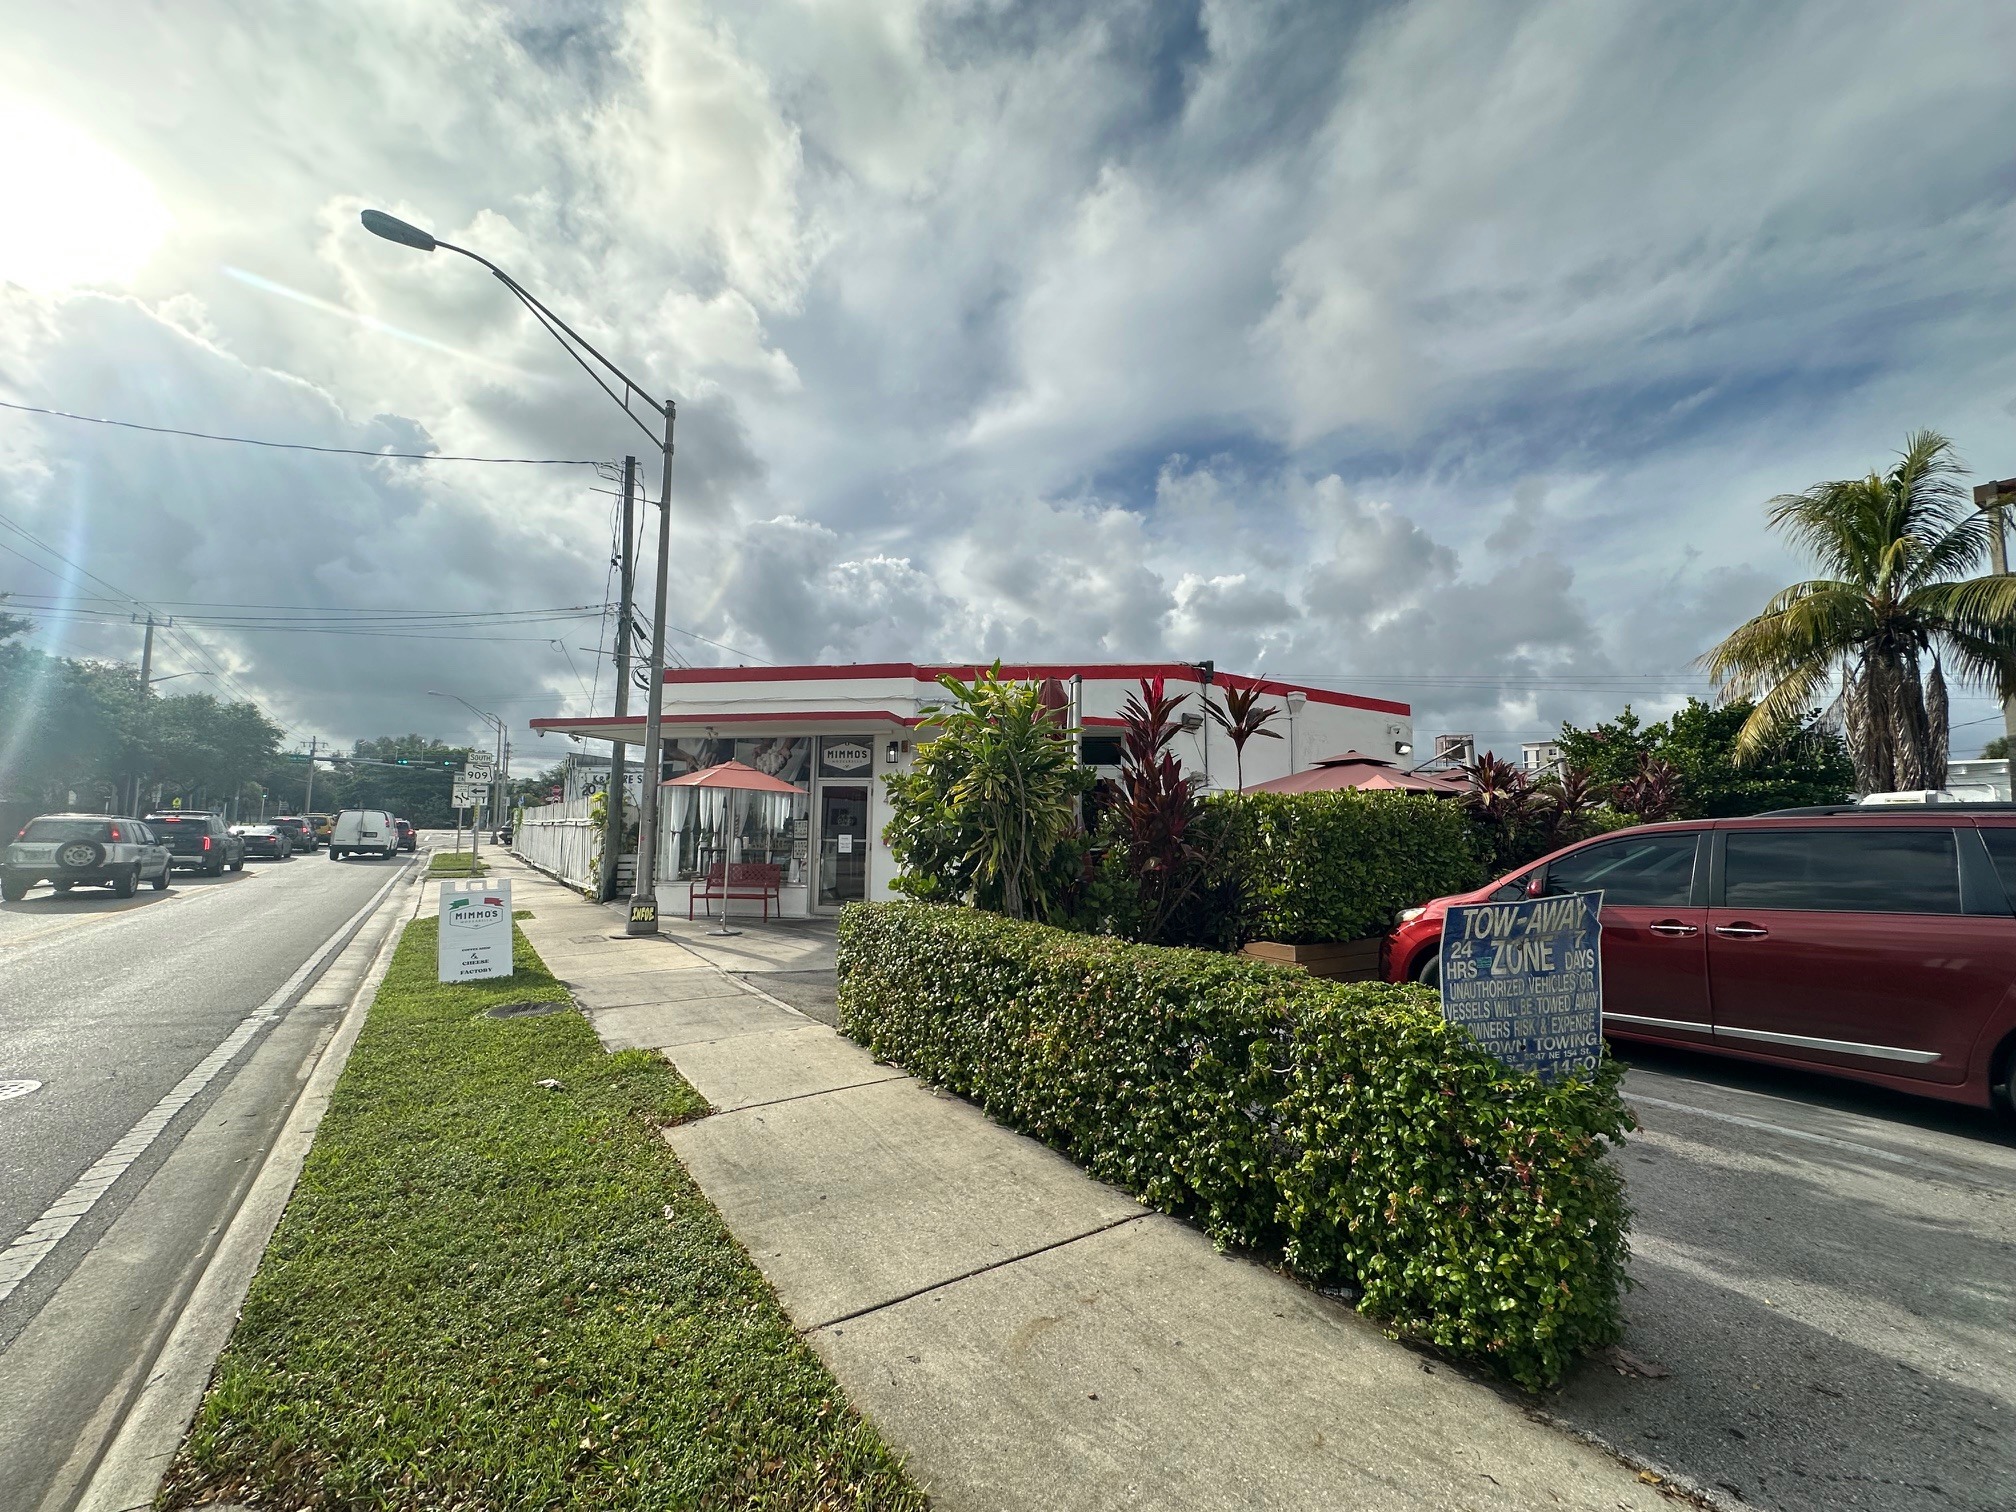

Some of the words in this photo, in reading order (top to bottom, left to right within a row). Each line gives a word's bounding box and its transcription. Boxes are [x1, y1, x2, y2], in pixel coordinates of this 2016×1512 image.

[470, 753, 491, 762] SOUTH
[467, 771, 488, 780] 909
[455, 909, 498, 921] MIMMO'S
[1462, 896, 1587, 940] TOW-AWAY
[470, 952, 478, 960] &
[1451, 941, 1473, 959] 24
[1490, 935, 1555, 976] ZONE
[1574, 930, 1586, 949] 7
[459, 967, 493, 976] FACTORY
[1446, 960, 1478, 980] HRS
[1564, 948, 1595, 971] DAYS
[1449, 978, 1525, 1001] UNAUTHORIZED
[1528, 973, 1576, 994] VEHICLES
[1579, 971, 1594, 990] OR
[1445, 1001, 1490, 1021] VESSELS
[1493, 999, 1518, 1018] WILL
[1520, 998, 1533, 1016] BE
[1536, 996, 1571, 1014] TOWED
[1574, 991, 1599, 1010] AWAY
[1467, 1020, 1511, 1040] OWNERS
[1514, 1018, 1536, 1037] RISK
[1540, 1017, 1548, 1034] &
[1551, 1013, 1595, 1034] EXPENSE
[1534, 1032, 1598, 1051] TOWING
[1548, 1051, 1561, 1059] NE
[1563, 1049, 1577, 1058] 154
[1580, 1047, 1592, 1055] St.
